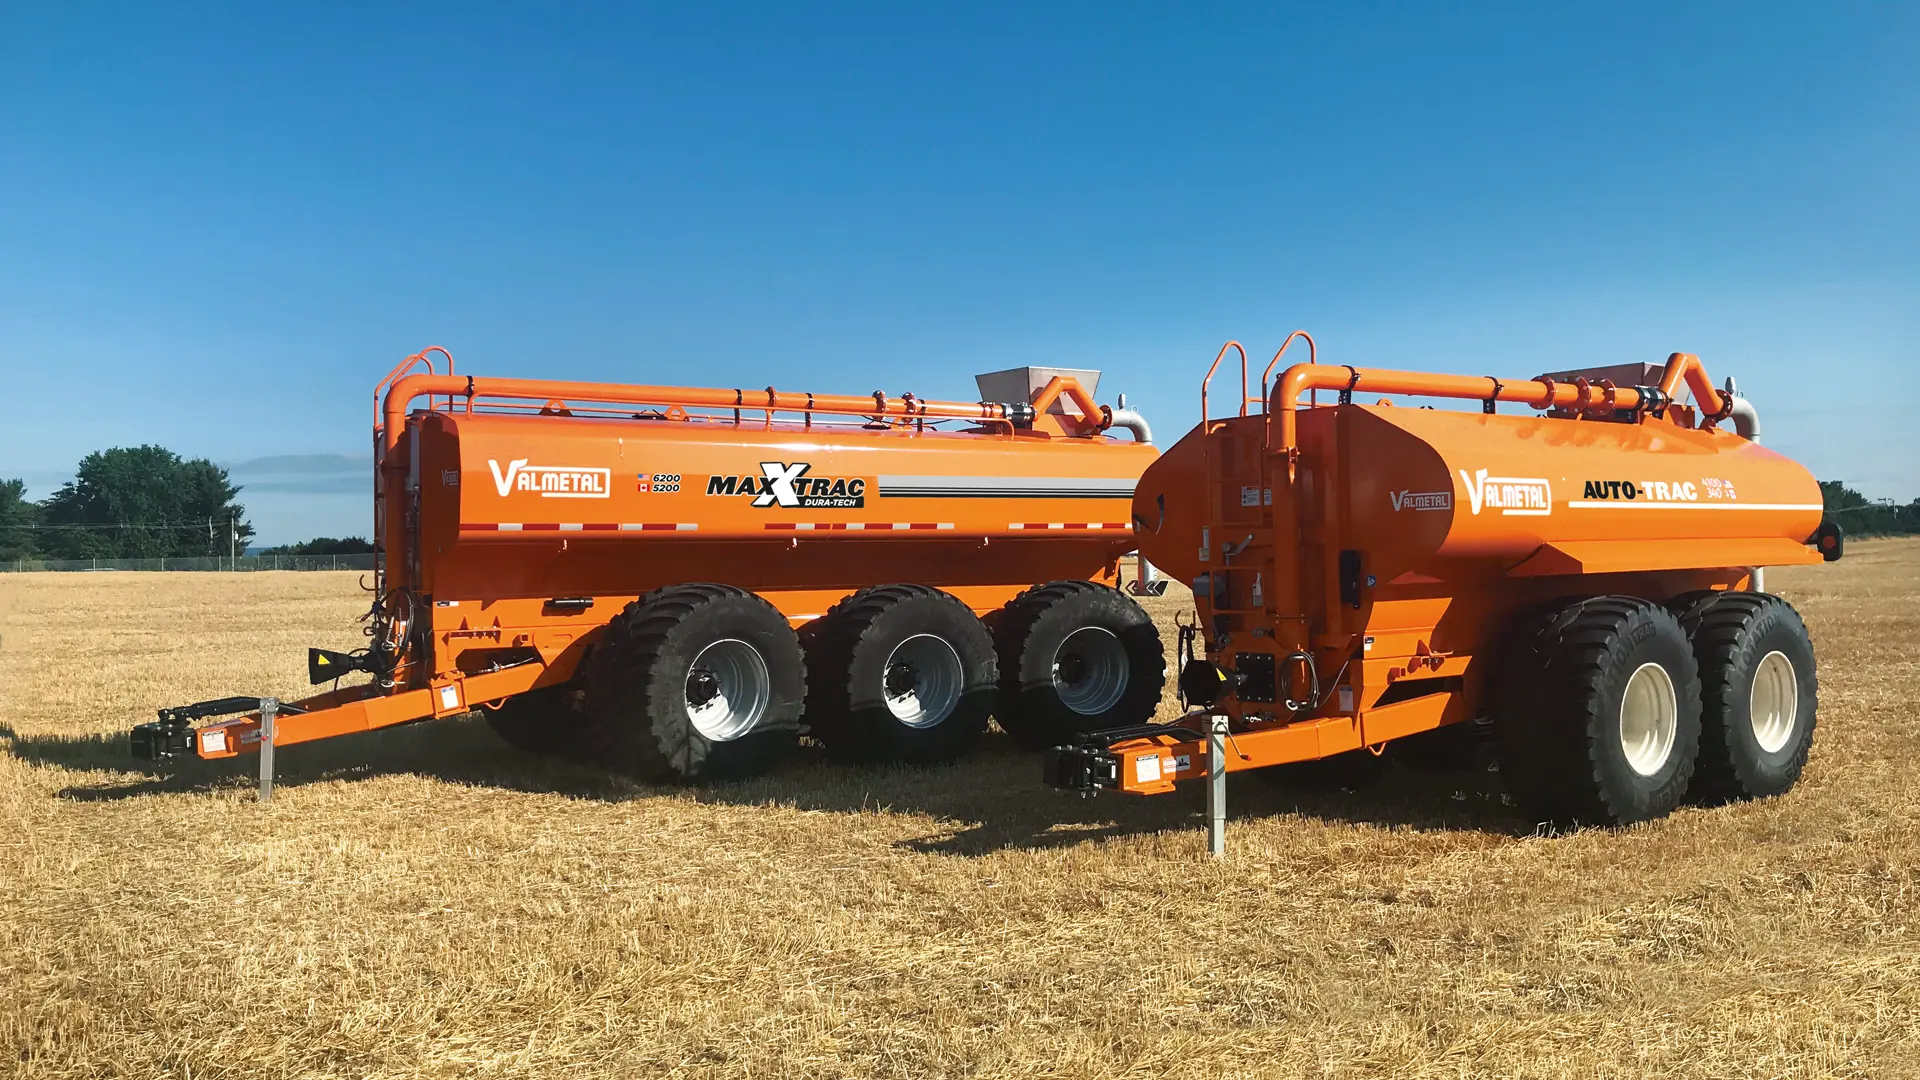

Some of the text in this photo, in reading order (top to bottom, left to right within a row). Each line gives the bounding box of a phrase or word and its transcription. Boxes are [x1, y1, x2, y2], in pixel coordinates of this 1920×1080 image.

[488, 458, 604, 498] VALMETAL
[652, 474, 681, 483] 6200
[652, 483, 680, 492] 5200
[1390, 489, 1447, 512] VALMETAL
[1458, 468, 1548, 515] VALMETAL
[1583, 480, 1698, 501] AUTO-TRAC
[804, 498, 856, 507] DURA-TECH
